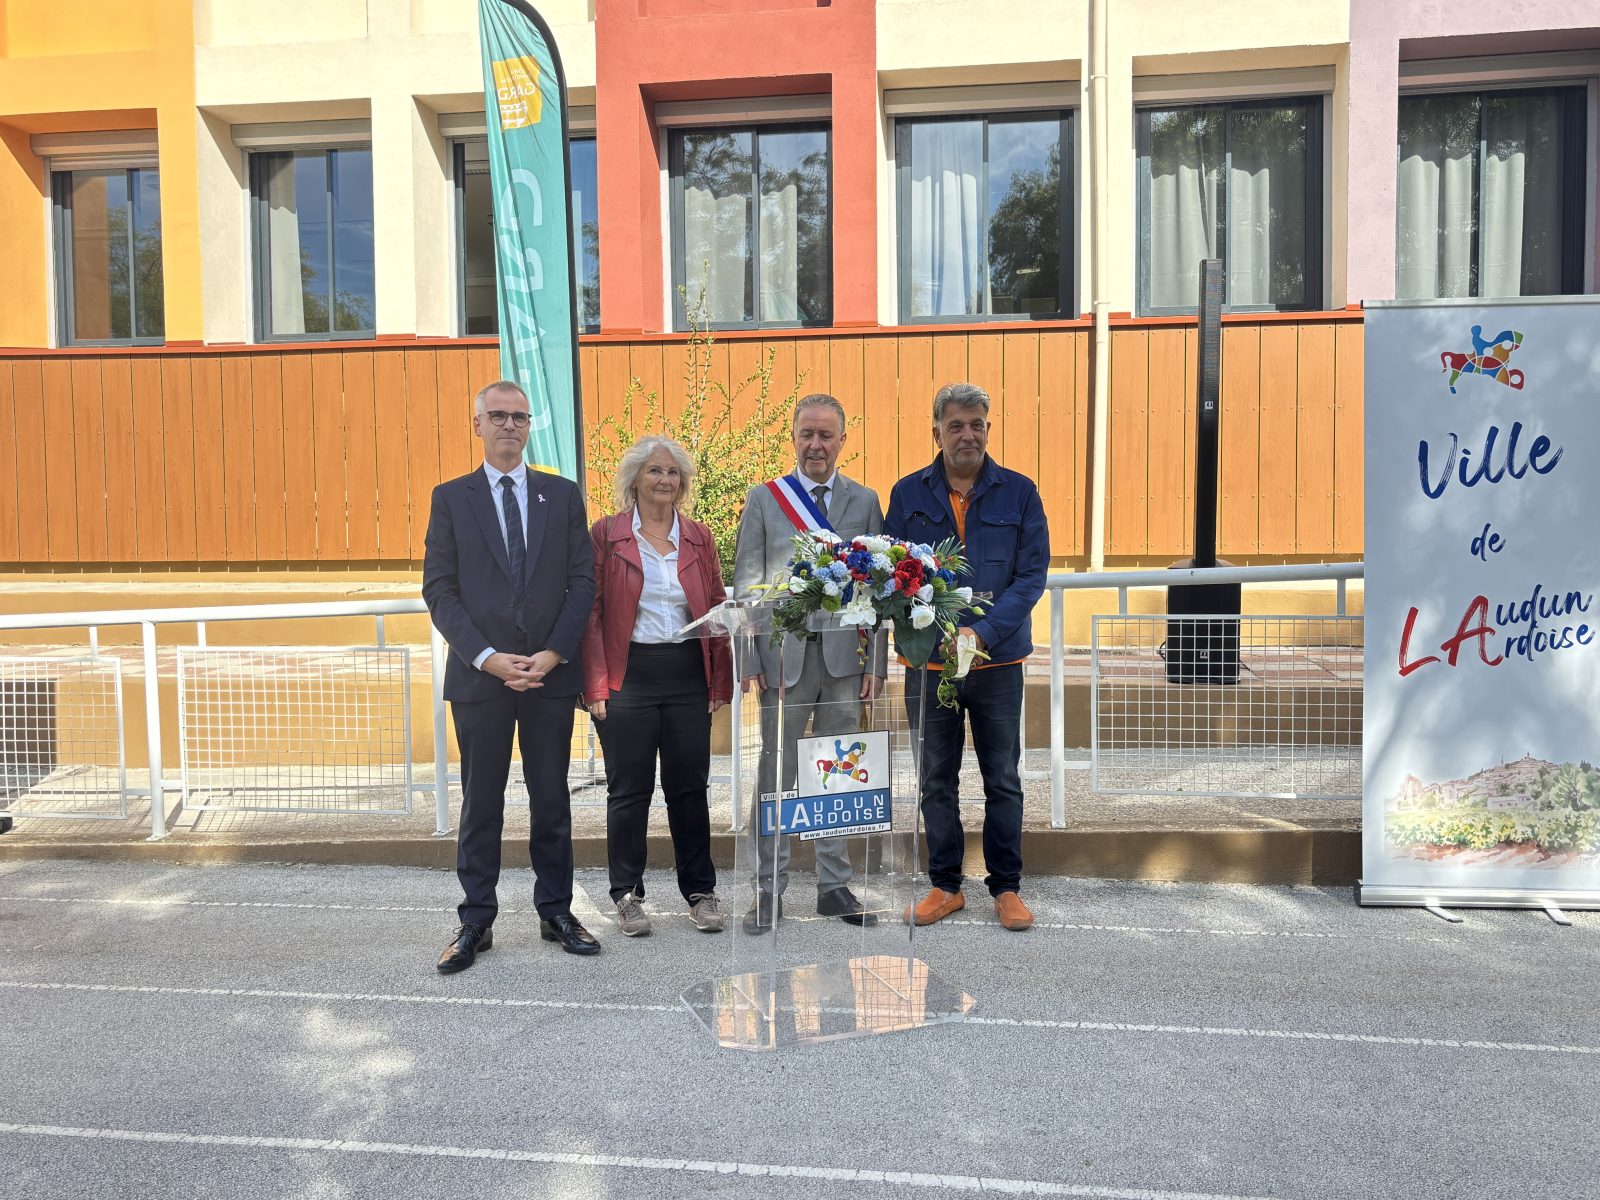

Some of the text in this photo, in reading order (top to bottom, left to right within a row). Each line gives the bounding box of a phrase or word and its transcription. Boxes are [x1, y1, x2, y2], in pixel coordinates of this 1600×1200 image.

[1418, 421, 1564, 499] Ville
[1470, 523, 1506, 561] de
[763, 793, 784, 801] Vill
[803, 823, 885, 839] www.laudunlardoise.fr
